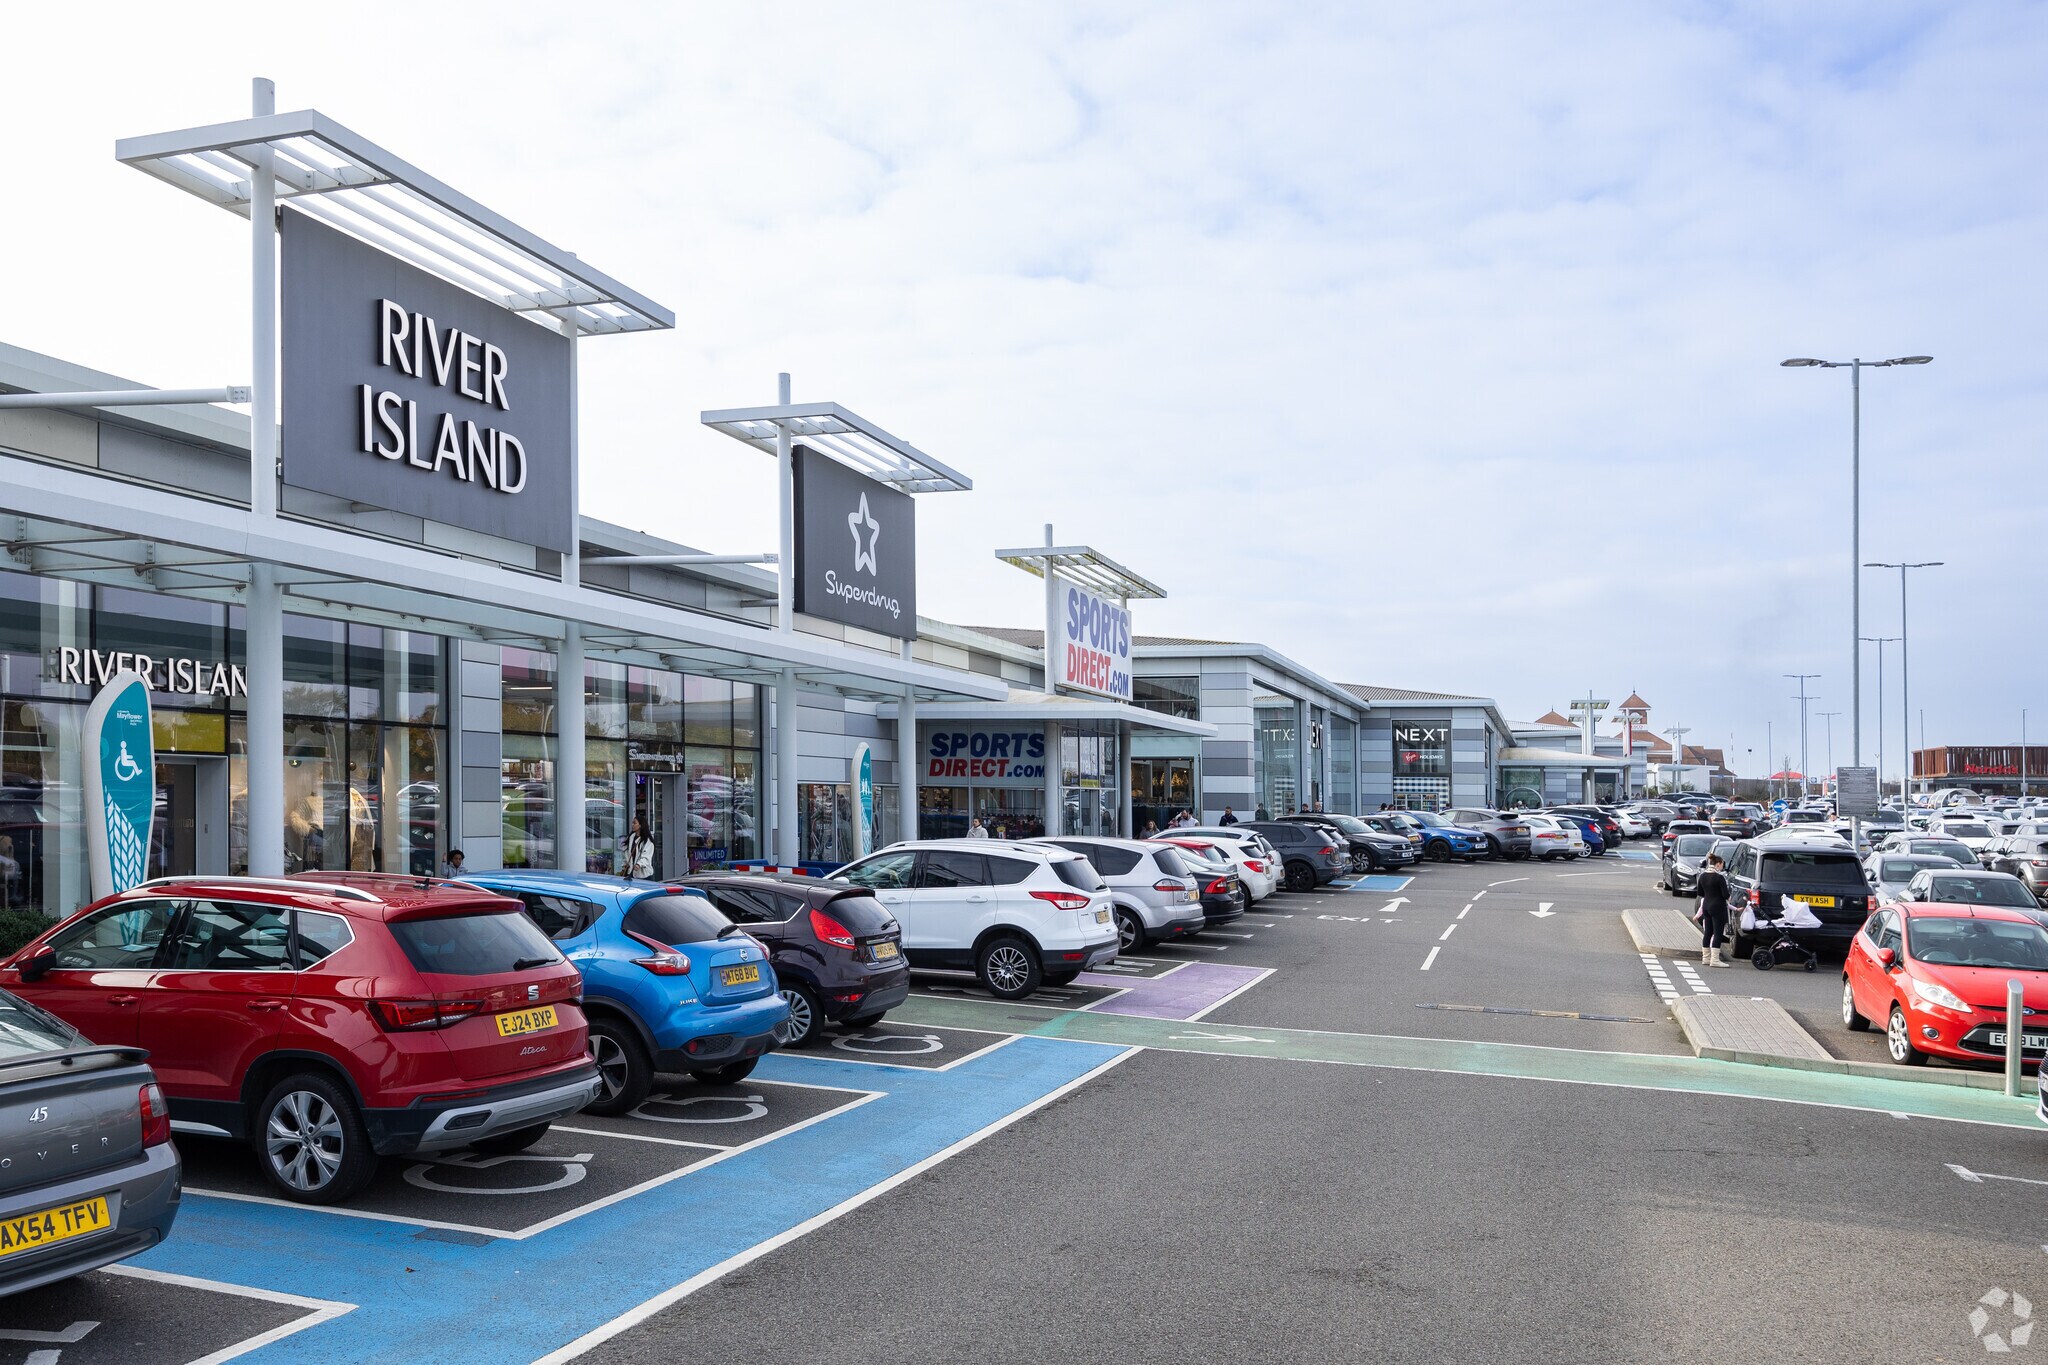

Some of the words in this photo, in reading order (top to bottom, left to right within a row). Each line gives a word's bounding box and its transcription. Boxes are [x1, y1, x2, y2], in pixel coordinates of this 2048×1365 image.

[378, 298, 510, 411] RIVER
[359, 383, 527, 494] ISLAND
[825, 570, 901, 619] Superdrug
[1067, 588, 1128, 658] SPORTS
[60, 646, 154, 690] RIVER
[167, 657, 248, 697] ISLAN
[1067, 643, 1129, 697] DIRECT.COM
[117, 712, 142, 720] Mayflower
[930, 732, 1045, 758] SPORTS
[1395, 728, 1449, 741] NEXT
[929, 759, 1045, 778] DIRECT.COM
[694, 849, 726, 860] UNLIMITED
[725, 969, 744, 983] MT68
[745, 966, 758, 979] BVC
[501, 1014, 531, 1034] EJ24
[532, 1010, 552, 1028] BXP
[520, 1046, 547, 1056] Ateca
[2030, 1036, 2048, 1048] LW
[29, 1106, 48, 1123] 45
[0, 1137, 109, 1168] OVER
[1, 1214, 56, 1250] AX54
[60, 1201, 99, 1232] TFV
